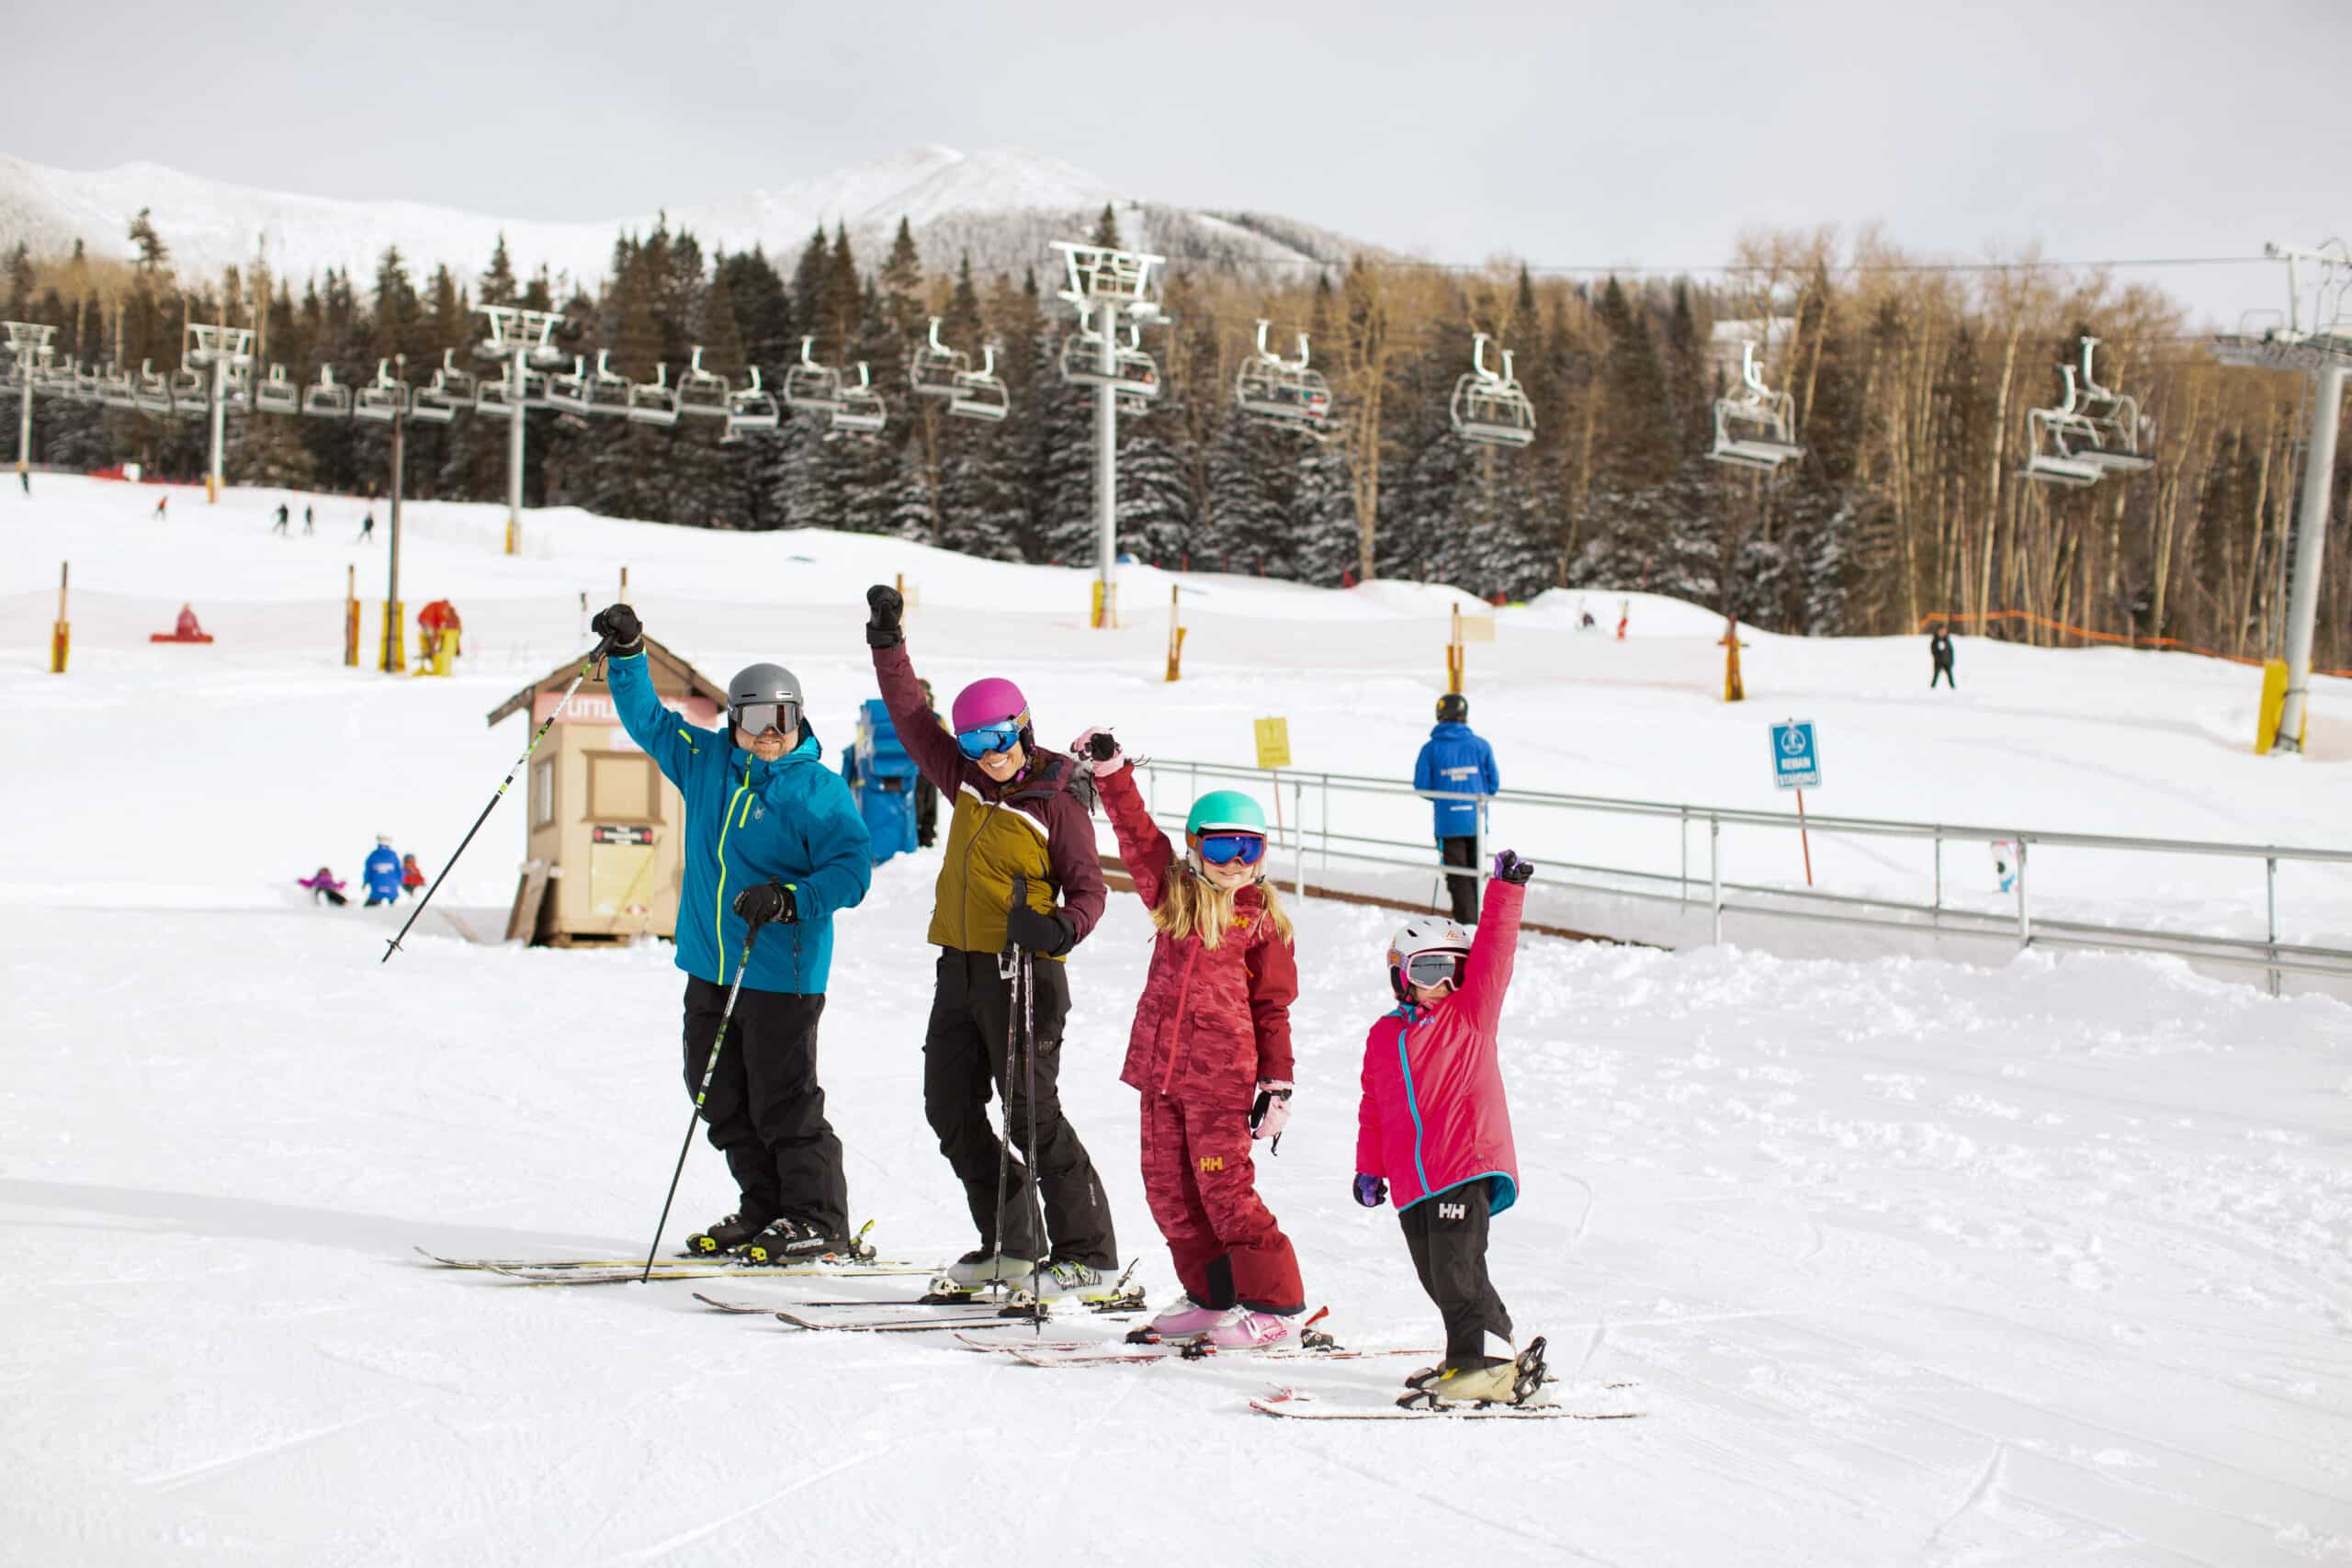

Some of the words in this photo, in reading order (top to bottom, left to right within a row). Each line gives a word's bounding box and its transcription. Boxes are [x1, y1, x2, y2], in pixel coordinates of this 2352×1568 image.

[567, 697, 615, 719] LITTL
[1200, 1156, 1223, 1172] HH
[1439, 1202, 1465, 1220] HH
